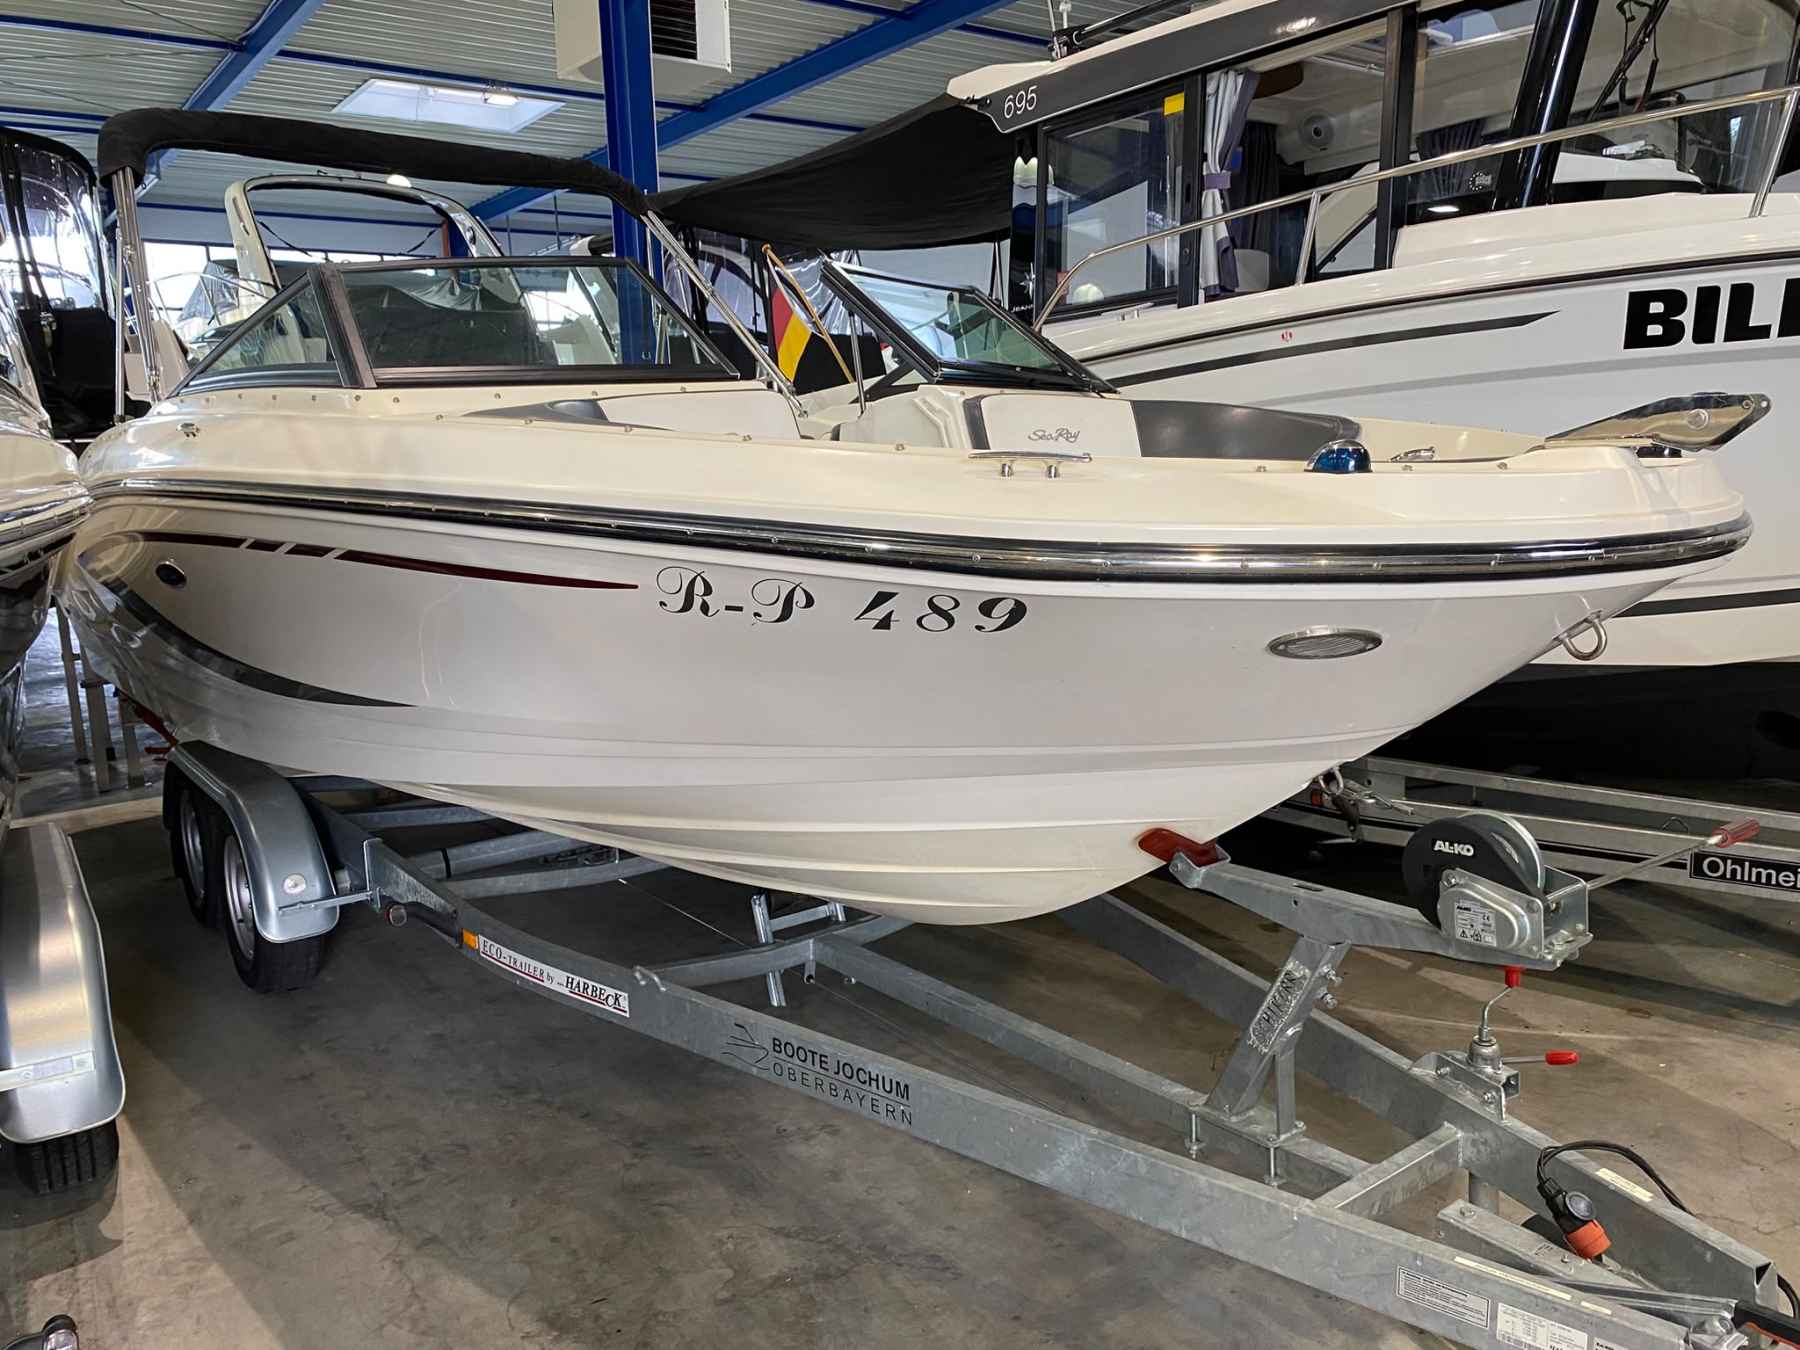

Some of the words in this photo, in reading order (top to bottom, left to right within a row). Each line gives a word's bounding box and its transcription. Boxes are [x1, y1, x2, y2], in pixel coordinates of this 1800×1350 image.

[1004, 85, 1037, 119] 695
[1623, 277, 1800, 350] BIL
[656, 566, 816, 626] R-P
[854, 590, 1028, 633] 489
[483, 939, 545, 978] ECO-TRAILER
[547, 971, 555, 985] by
[772, 1037, 830, 1073] BOOTE
[834, 1059, 910, 1101] JOCHUM
[773, 1062, 913, 1128] OBERBAYERN
